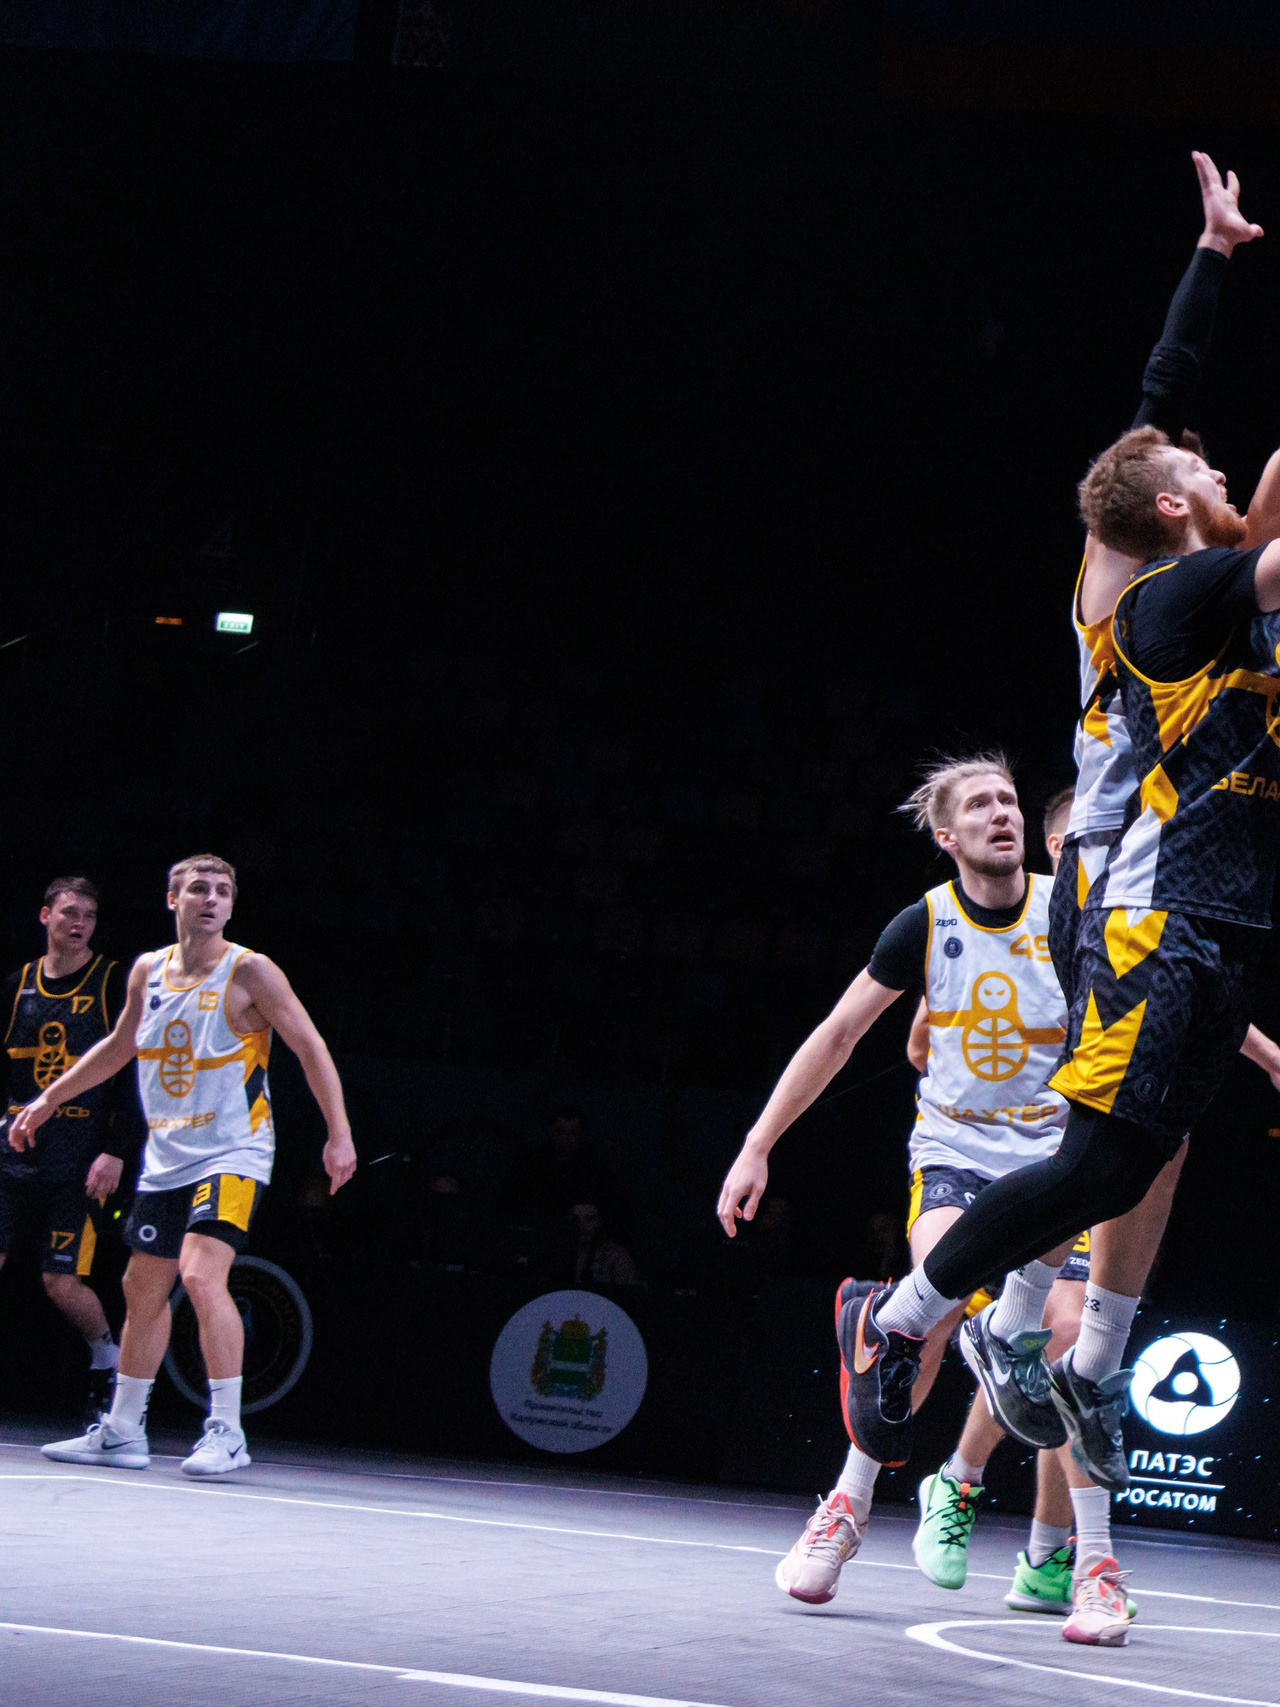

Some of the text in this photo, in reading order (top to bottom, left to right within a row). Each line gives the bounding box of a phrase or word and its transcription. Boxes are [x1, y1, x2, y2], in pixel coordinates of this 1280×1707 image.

[71, 995, 94, 1014] 17
[51, 1230, 75, 1250] 17
[1130, 1449, 1214, 1477] ПАТЭС
[1116, 1487, 1217, 1512] РОСАТОМ
